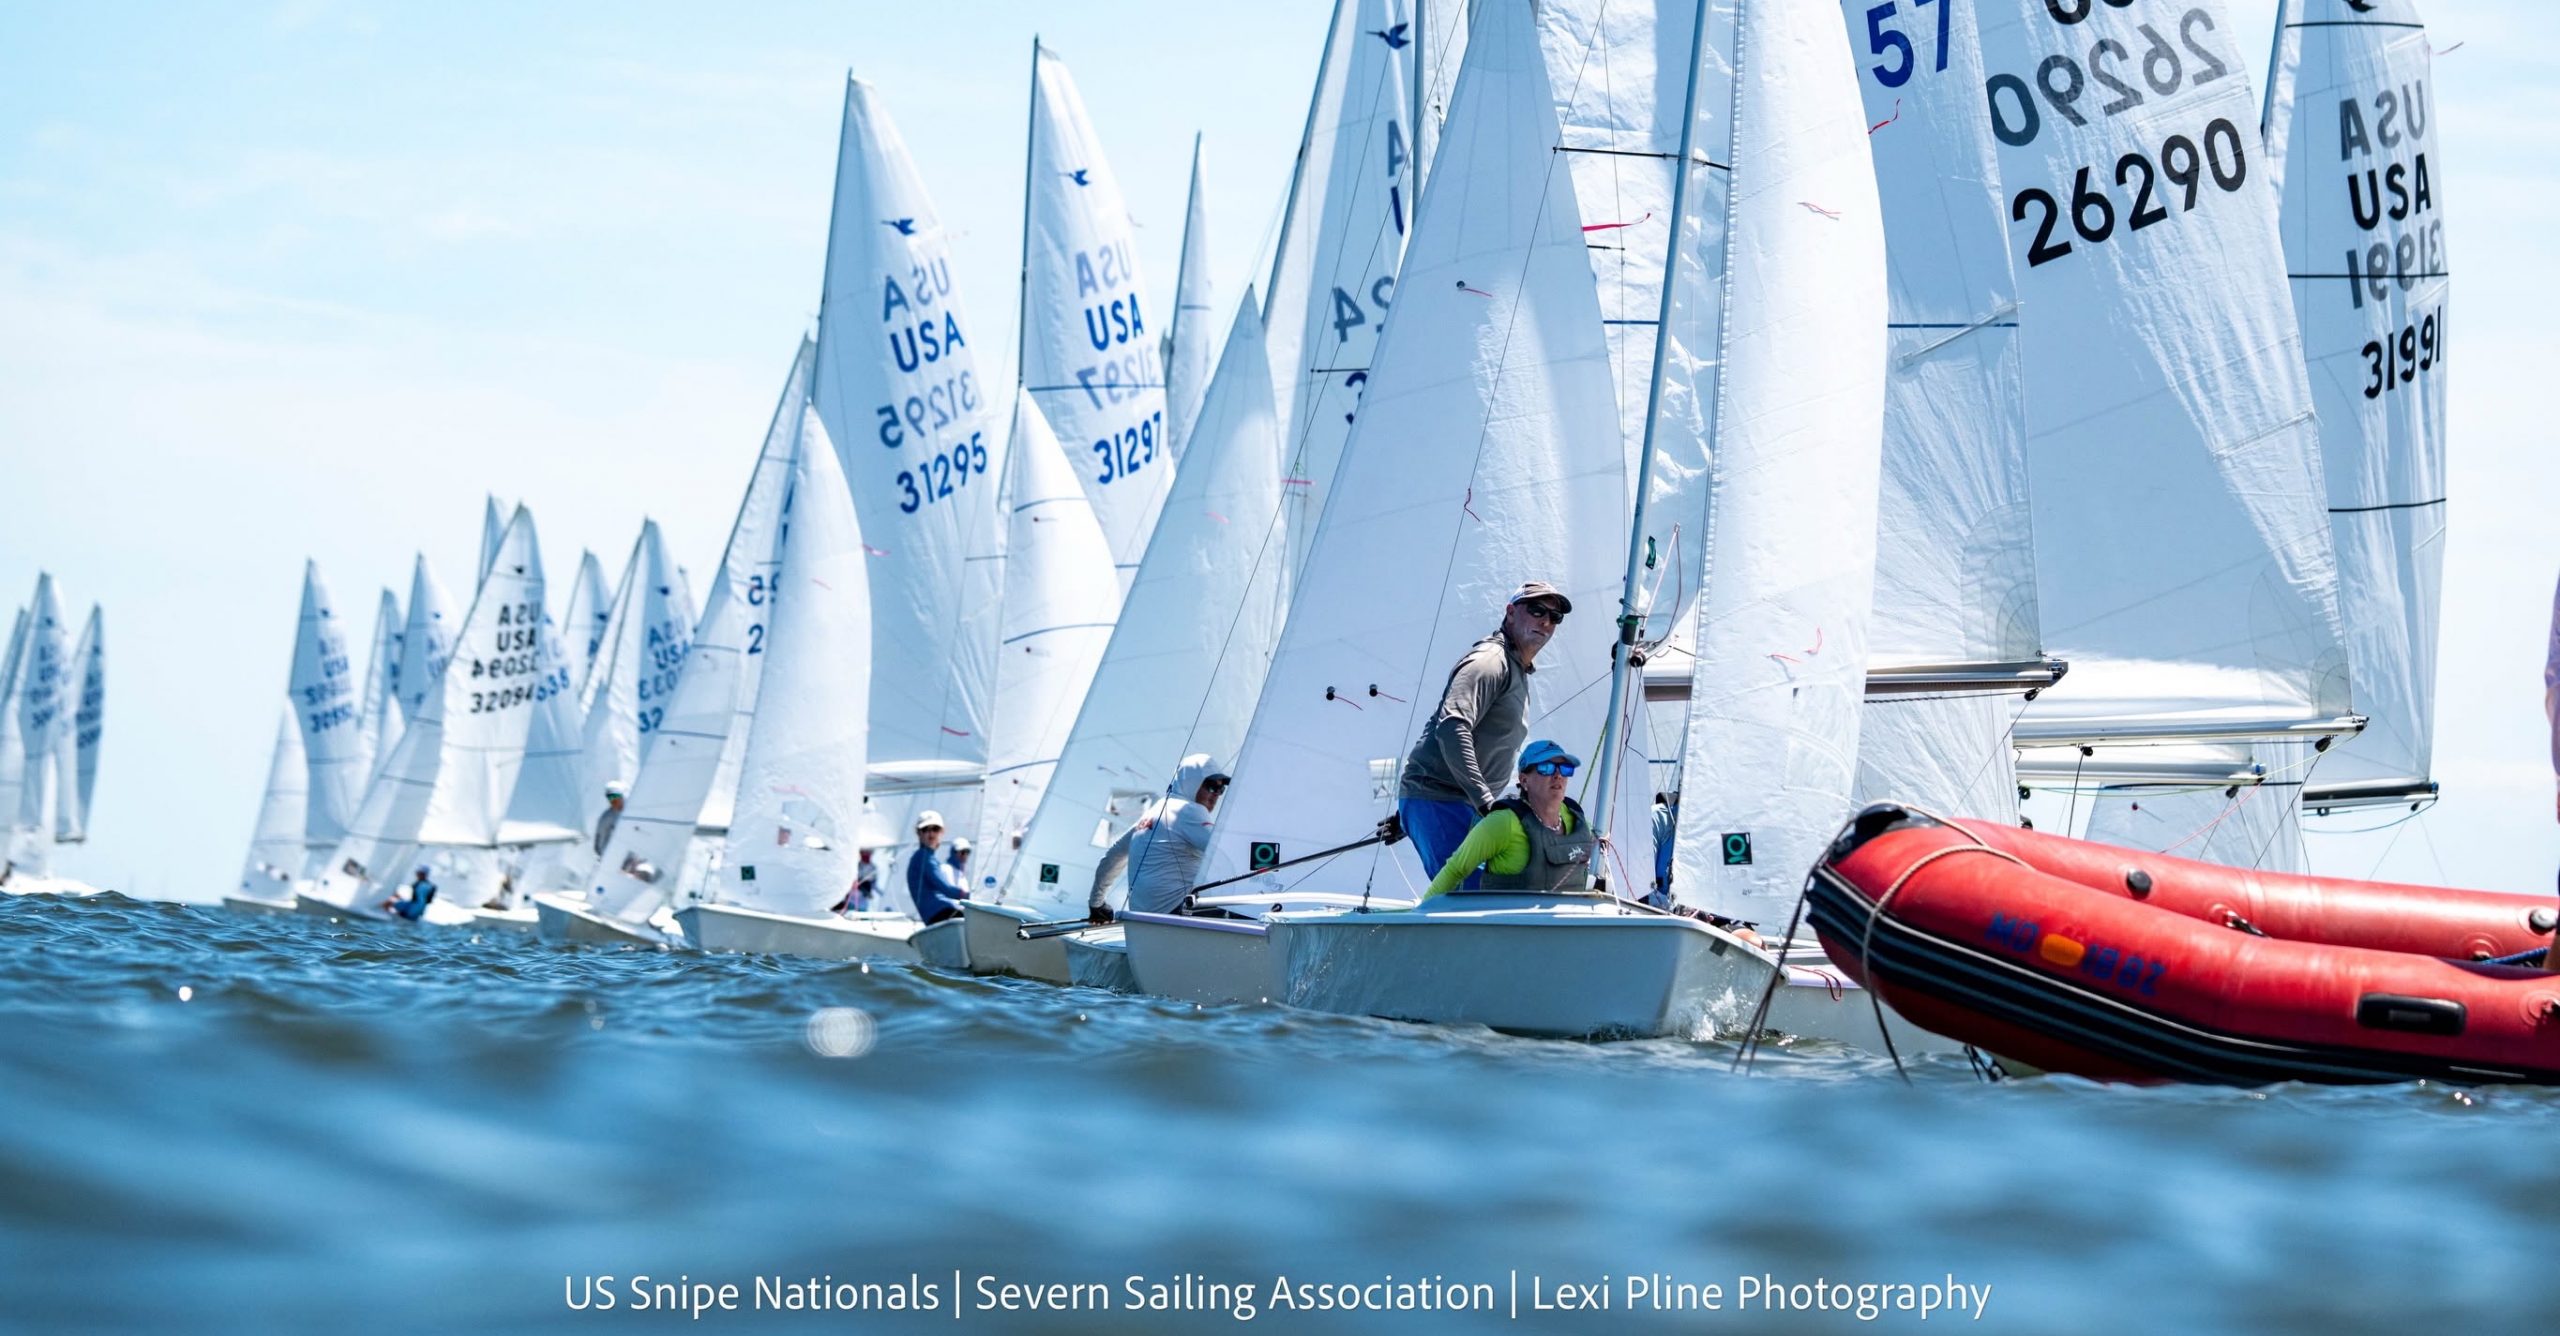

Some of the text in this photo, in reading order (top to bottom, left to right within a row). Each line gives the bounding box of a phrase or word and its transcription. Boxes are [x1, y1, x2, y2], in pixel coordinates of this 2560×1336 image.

[2012, 118, 2247, 268] 26290
[2347, 152, 2432, 231] USA
[890, 310, 965, 374] USA
[1085, 292, 1145, 352] USA
[2361, 304, 2442, 400] 31991
[896, 431, 988, 515] 31295
[1093, 410, 1162, 485] 31297
[496, 627, 538, 653] USA
